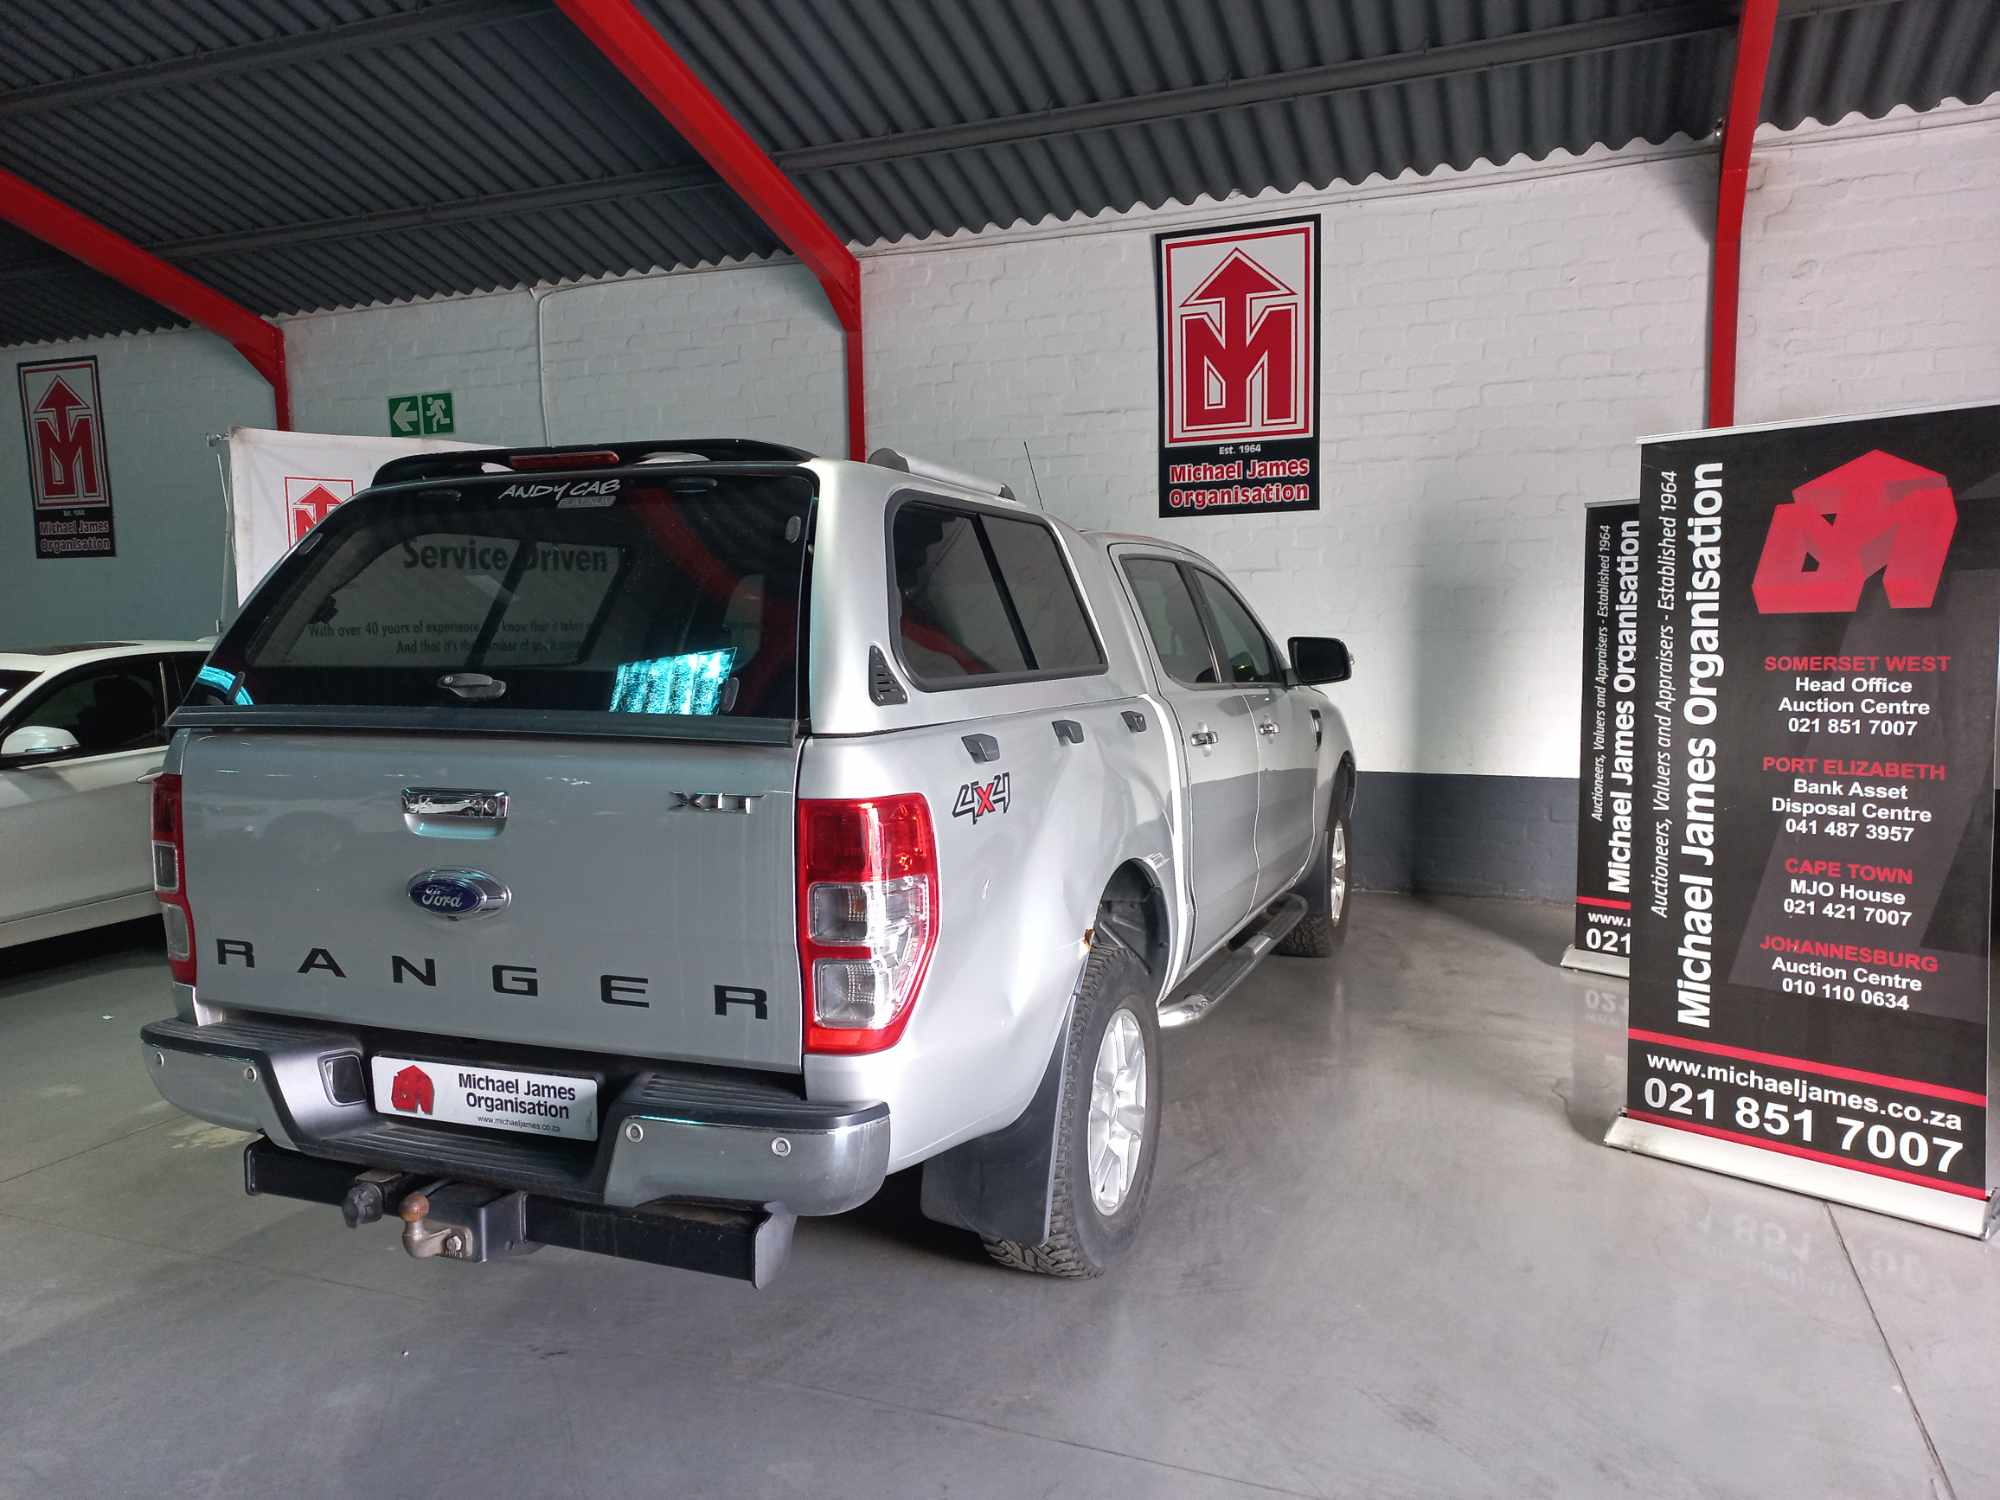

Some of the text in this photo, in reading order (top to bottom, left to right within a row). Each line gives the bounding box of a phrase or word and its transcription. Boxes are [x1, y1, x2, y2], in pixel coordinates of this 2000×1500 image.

[1218, 443, 1261, 455] Est. 1964
[1169, 458, 1310, 483] Michael James
[498, 479, 620, 500] ANDY CAB
[1169, 482, 1310, 509] Organisation
[1660, 470, 1678, 512] 1964
[39, 520, 109, 535] Michael James
[1600, 525, 1611, 551] 1964
[40, 537, 111, 553] Organisation
[402, 538, 509, 571] Service
[1657, 516, 1676, 611] Established
[1597, 555, 1610, 618] Established
[365, 621, 378, 635] 40
[381, 624, 411, 638] years
[396, 639, 417, 654] And
[1595, 624, 1609, 683] Appraisers
[1655, 624, 1676, 712] Appraisers
[1764, 656, 1951, 672] SOMERSET WEST
[1594, 684, 1607, 707] and
[1795, 677, 1913, 693] Head Office
[1608, 520, 1640, 894] Michael James Organisation
[1778, 697, 1931, 715] Auction Centre
[1593, 708, 1606, 750] Valuers
[1654, 714, 1671, 747] and
[1788, 718, 1918, 736] 021 851 7007
[1677, 462, 1724, 1028] Michael James Organisation
[1652, 750, 1671, 812] Valuers
[1762, 756, 1946, 781] PORT ELIZABETH
[1591, 755, 1606, 821] Auctioneers,
[1794, 778, 1909, 800] Bank Asset
[1772, 797, 1932, 822] Disposal Centre
[1785, 818, 1915, 842] 041 487 3957
[1651, 818, 1672, 918] Auctioneers,
[1785, 857, 1914, 885] CAPE TOWN
[422, 887, 462, 908] Ford
[1790, 879, 1906, 905] MJO House
[1783, 898, 1912, 927] 021 421 7007
[1585, 928, 1631, 954] 021
[1760, 935, 1939, 972] JOHANNESBURG
[216, 938, 768, 1020] RANGER
[1772, 957, 1923, 991] Auction Centre
[1782, 978, 1910, 1011] 010 110 0634
[458, 1073, 576, 1101] Michael James
[1647, 1052, 1962, 1132] www.michaeljames.co.za
[466, 1092, 569, 1120] Organisation
[1643, 1077, 1964, 1174] 021 851 7007
